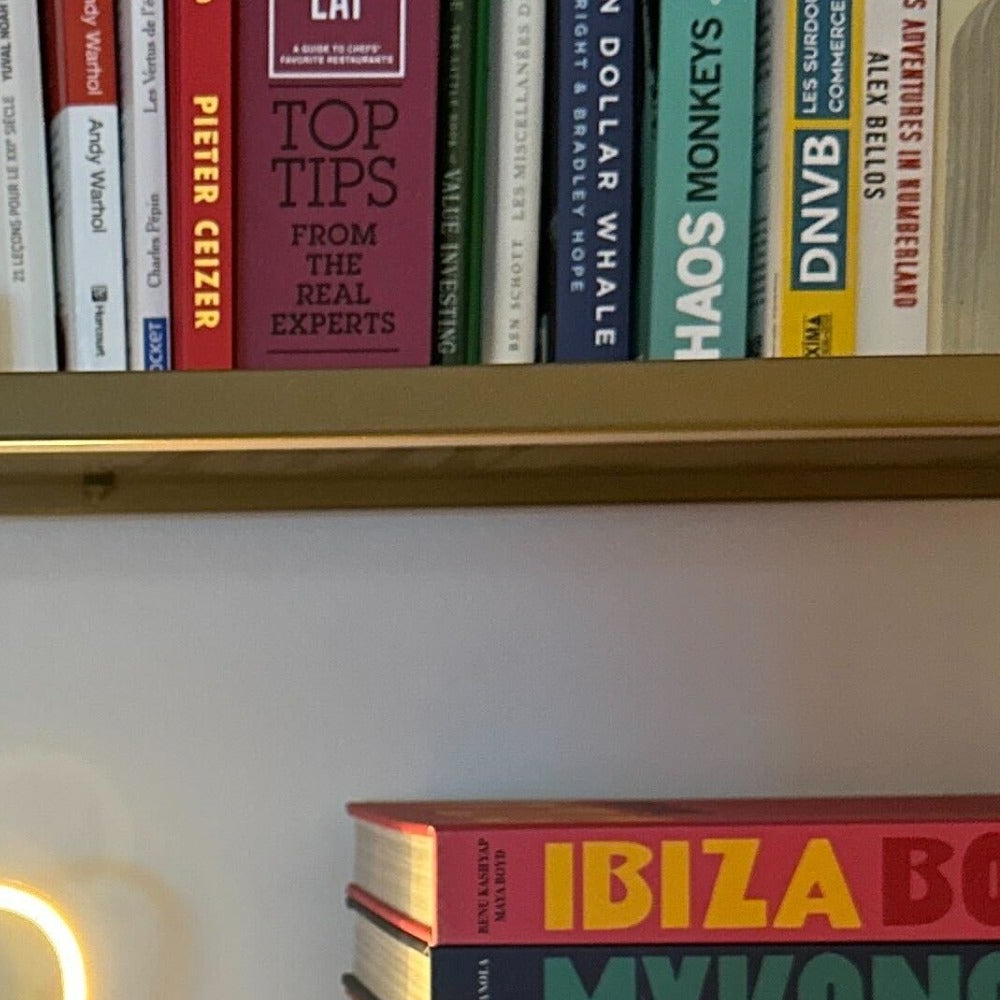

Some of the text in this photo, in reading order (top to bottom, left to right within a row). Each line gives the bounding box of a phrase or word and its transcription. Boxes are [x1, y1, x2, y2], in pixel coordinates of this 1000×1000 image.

[140, 20, 157, 37] de
[802, 0, 820, 114] LES SURDO
[828, 0, 846, 113] COMMERCE
[0, 43, 13, 81] YUVAL
[85, 30, 104, 96] Warhol
[141, 42, 158, 85] Vertus
[897, 19, 927, 144] ADVENTURES
[143, 89, 158, 113] Les
[272, 99, 399, 152] TOP
[595, 37, 621, 191] DOLLAR
[686, 17, 724, 203] MONKEYS
[863, 51, 889, 200] ALEX BELLOS
[6, 166, 19, 179] LE
[85, 117, 108, 233] Andy Warhol
[272, 155, 398, 209] TIPS
[571, 106, 588, 218] BRADLEY
[895, 150, 922, 171] IN
[7, 184, 21, 216] POUR
[192, 95, 221, 329] PIETER CEIZER
[440, 168, 462, 235] VALUE
[511, 186, 525, 222] LES
[799, 134, 841, 284] DNVB
[146, 237, 162, 289] Charles
[291, 223, 378, 246] FROM
[305, 253, 363, 276] THE
[570, 230, 585, 293] HOPE
[892, 178, 922, 309] NUMBERLAND
[295, 283, 372, 306] REAL
[437, 244, 461, 355] INVESTING
[508, 239, 524, 352] BEN SCHOTT
[594, 211, 619, 347] WHALE
[271, 312, 396, 336] EXPERTS
[543, 837, 863, 932] IBIZA
